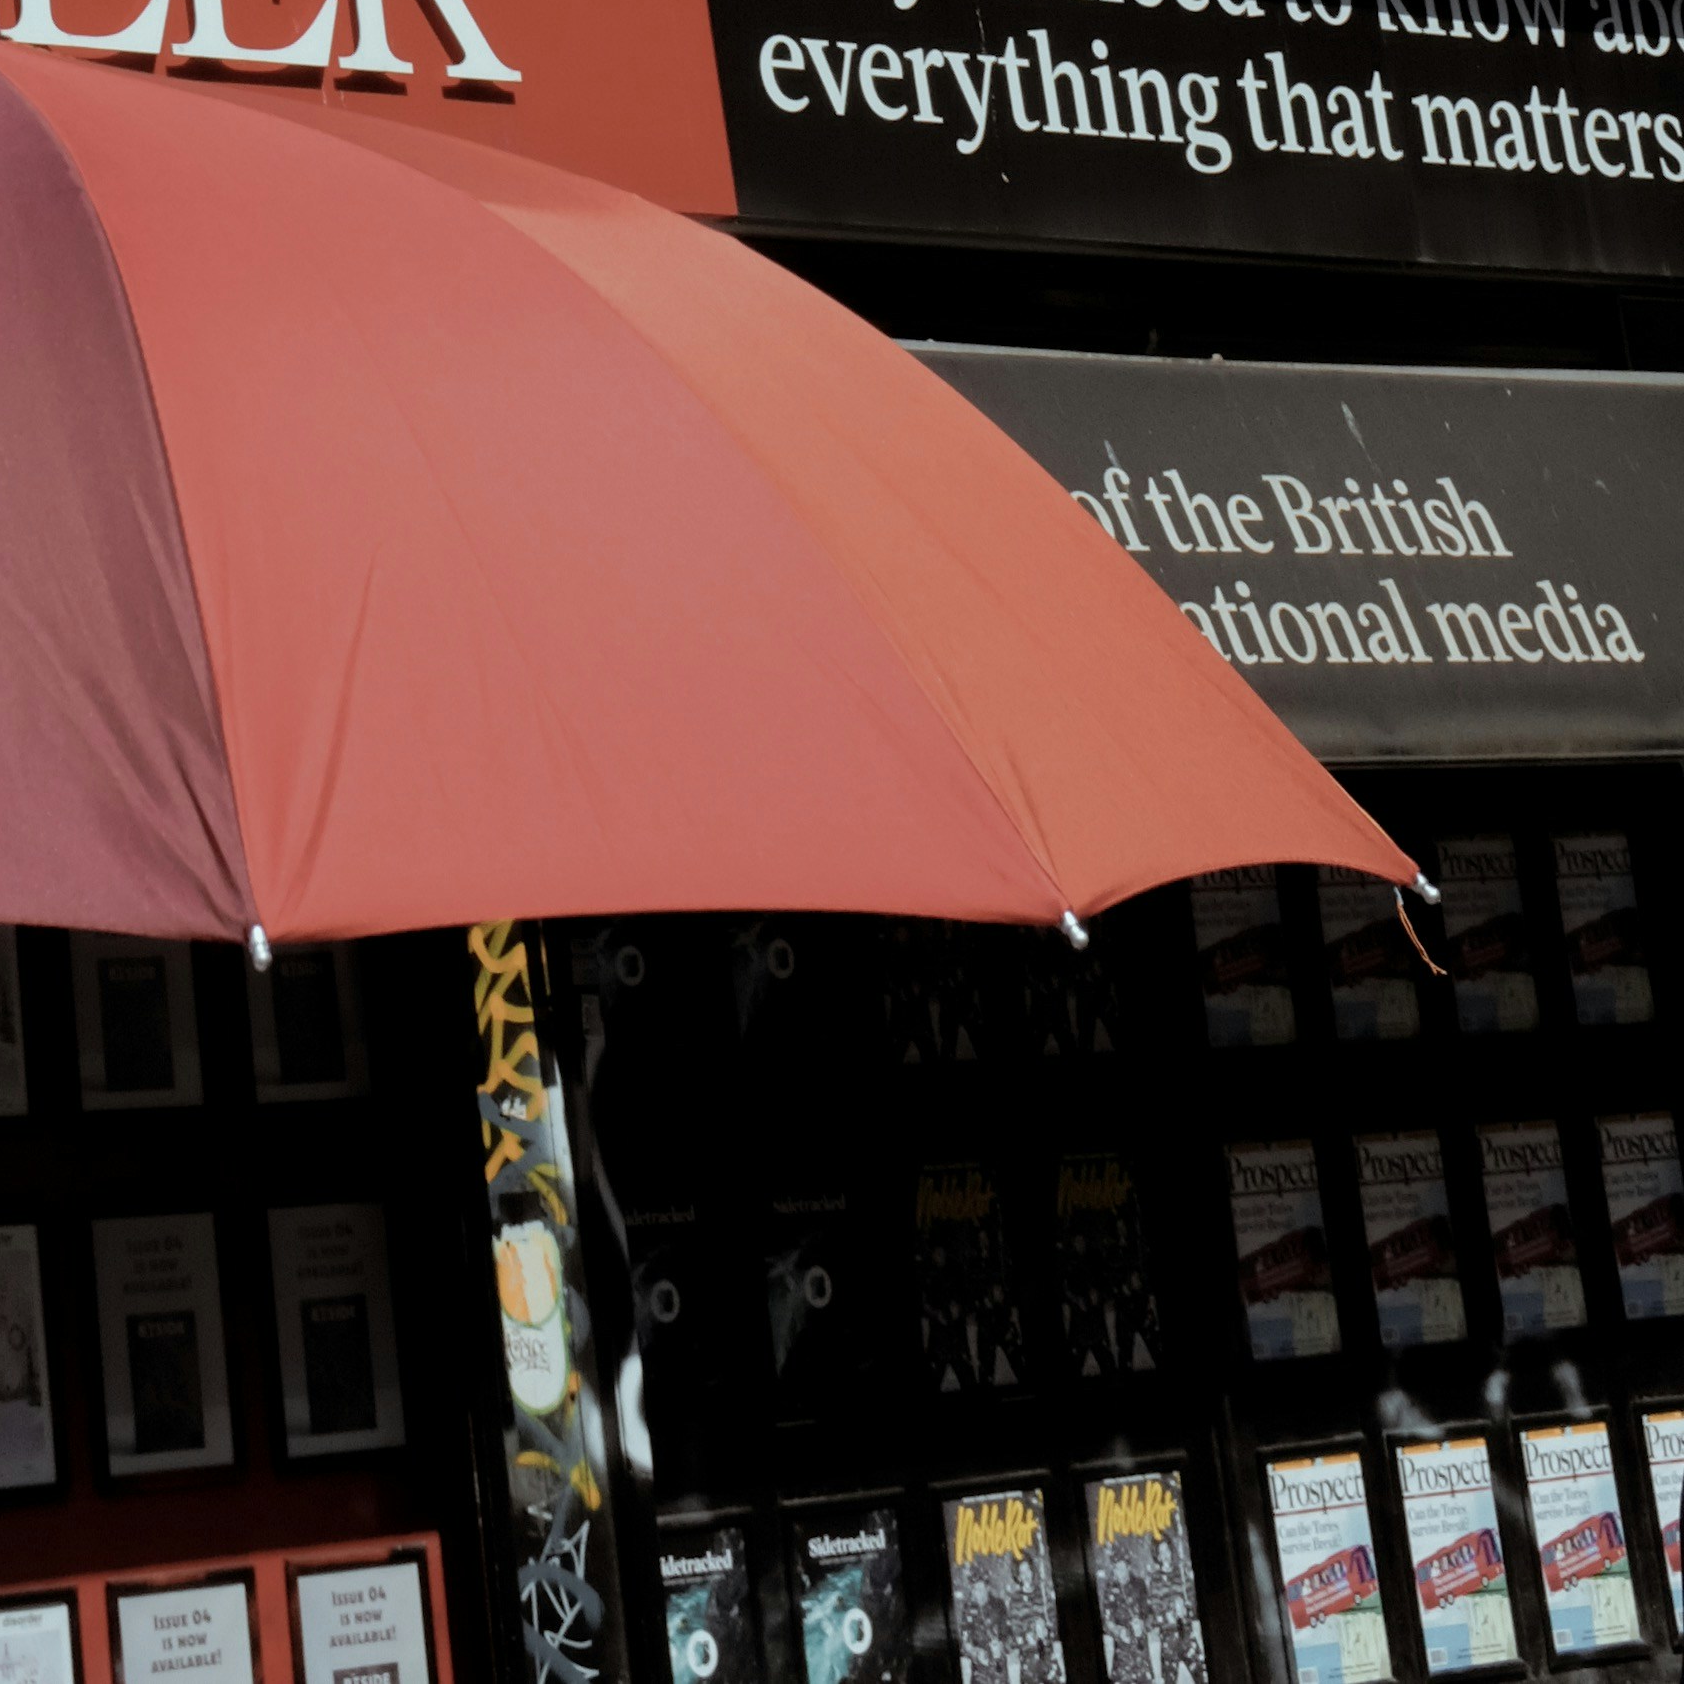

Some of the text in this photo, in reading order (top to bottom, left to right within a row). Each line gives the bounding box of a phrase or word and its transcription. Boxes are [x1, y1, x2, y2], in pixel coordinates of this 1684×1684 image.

[758, 28, 1684, 183] everything that matters
[1144, 469, 1275, 554] the
[1262, 472, 1513, 558] British
[1425, 581, 1645, 664] media
[1399, 1448, 1490, 1498] Prospect
[1524, 1435, 1610, 1482] Prospect
[1268, 1464, 1364, 1515] Prospect
[807, 1527, 887, 1559] Sidetracked
[192, 1608, 212, 1625] 04
[368, 1585, 386, 1603] 04
